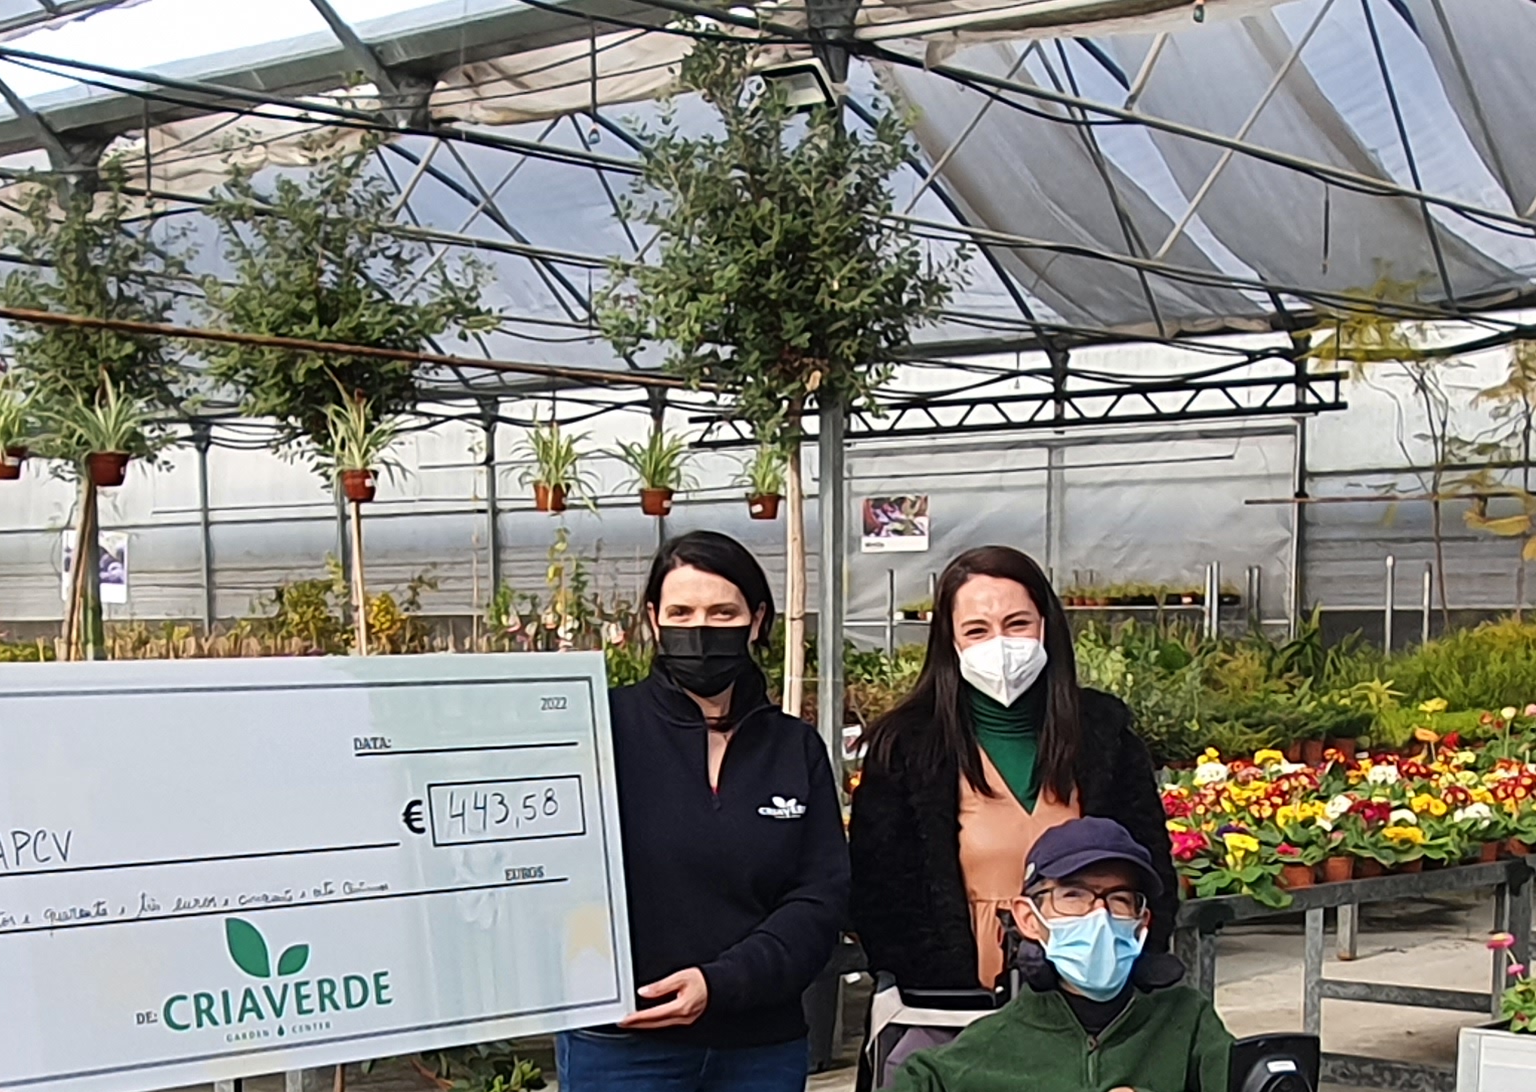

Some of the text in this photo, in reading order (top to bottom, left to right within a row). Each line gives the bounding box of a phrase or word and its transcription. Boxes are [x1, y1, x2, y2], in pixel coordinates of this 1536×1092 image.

[541, 697, 567, 711] 2022
[353, 737, 392, 750] DATA:
[402, 799, 426, 834] €
[449, 788, 559, 835] 443,58
[505, 865, 545, 881] EUROS
[135, 970, 394, 1031] DE: CRIAVERDE
[225, 1021, 332, 1042] GARDEN CENTER
